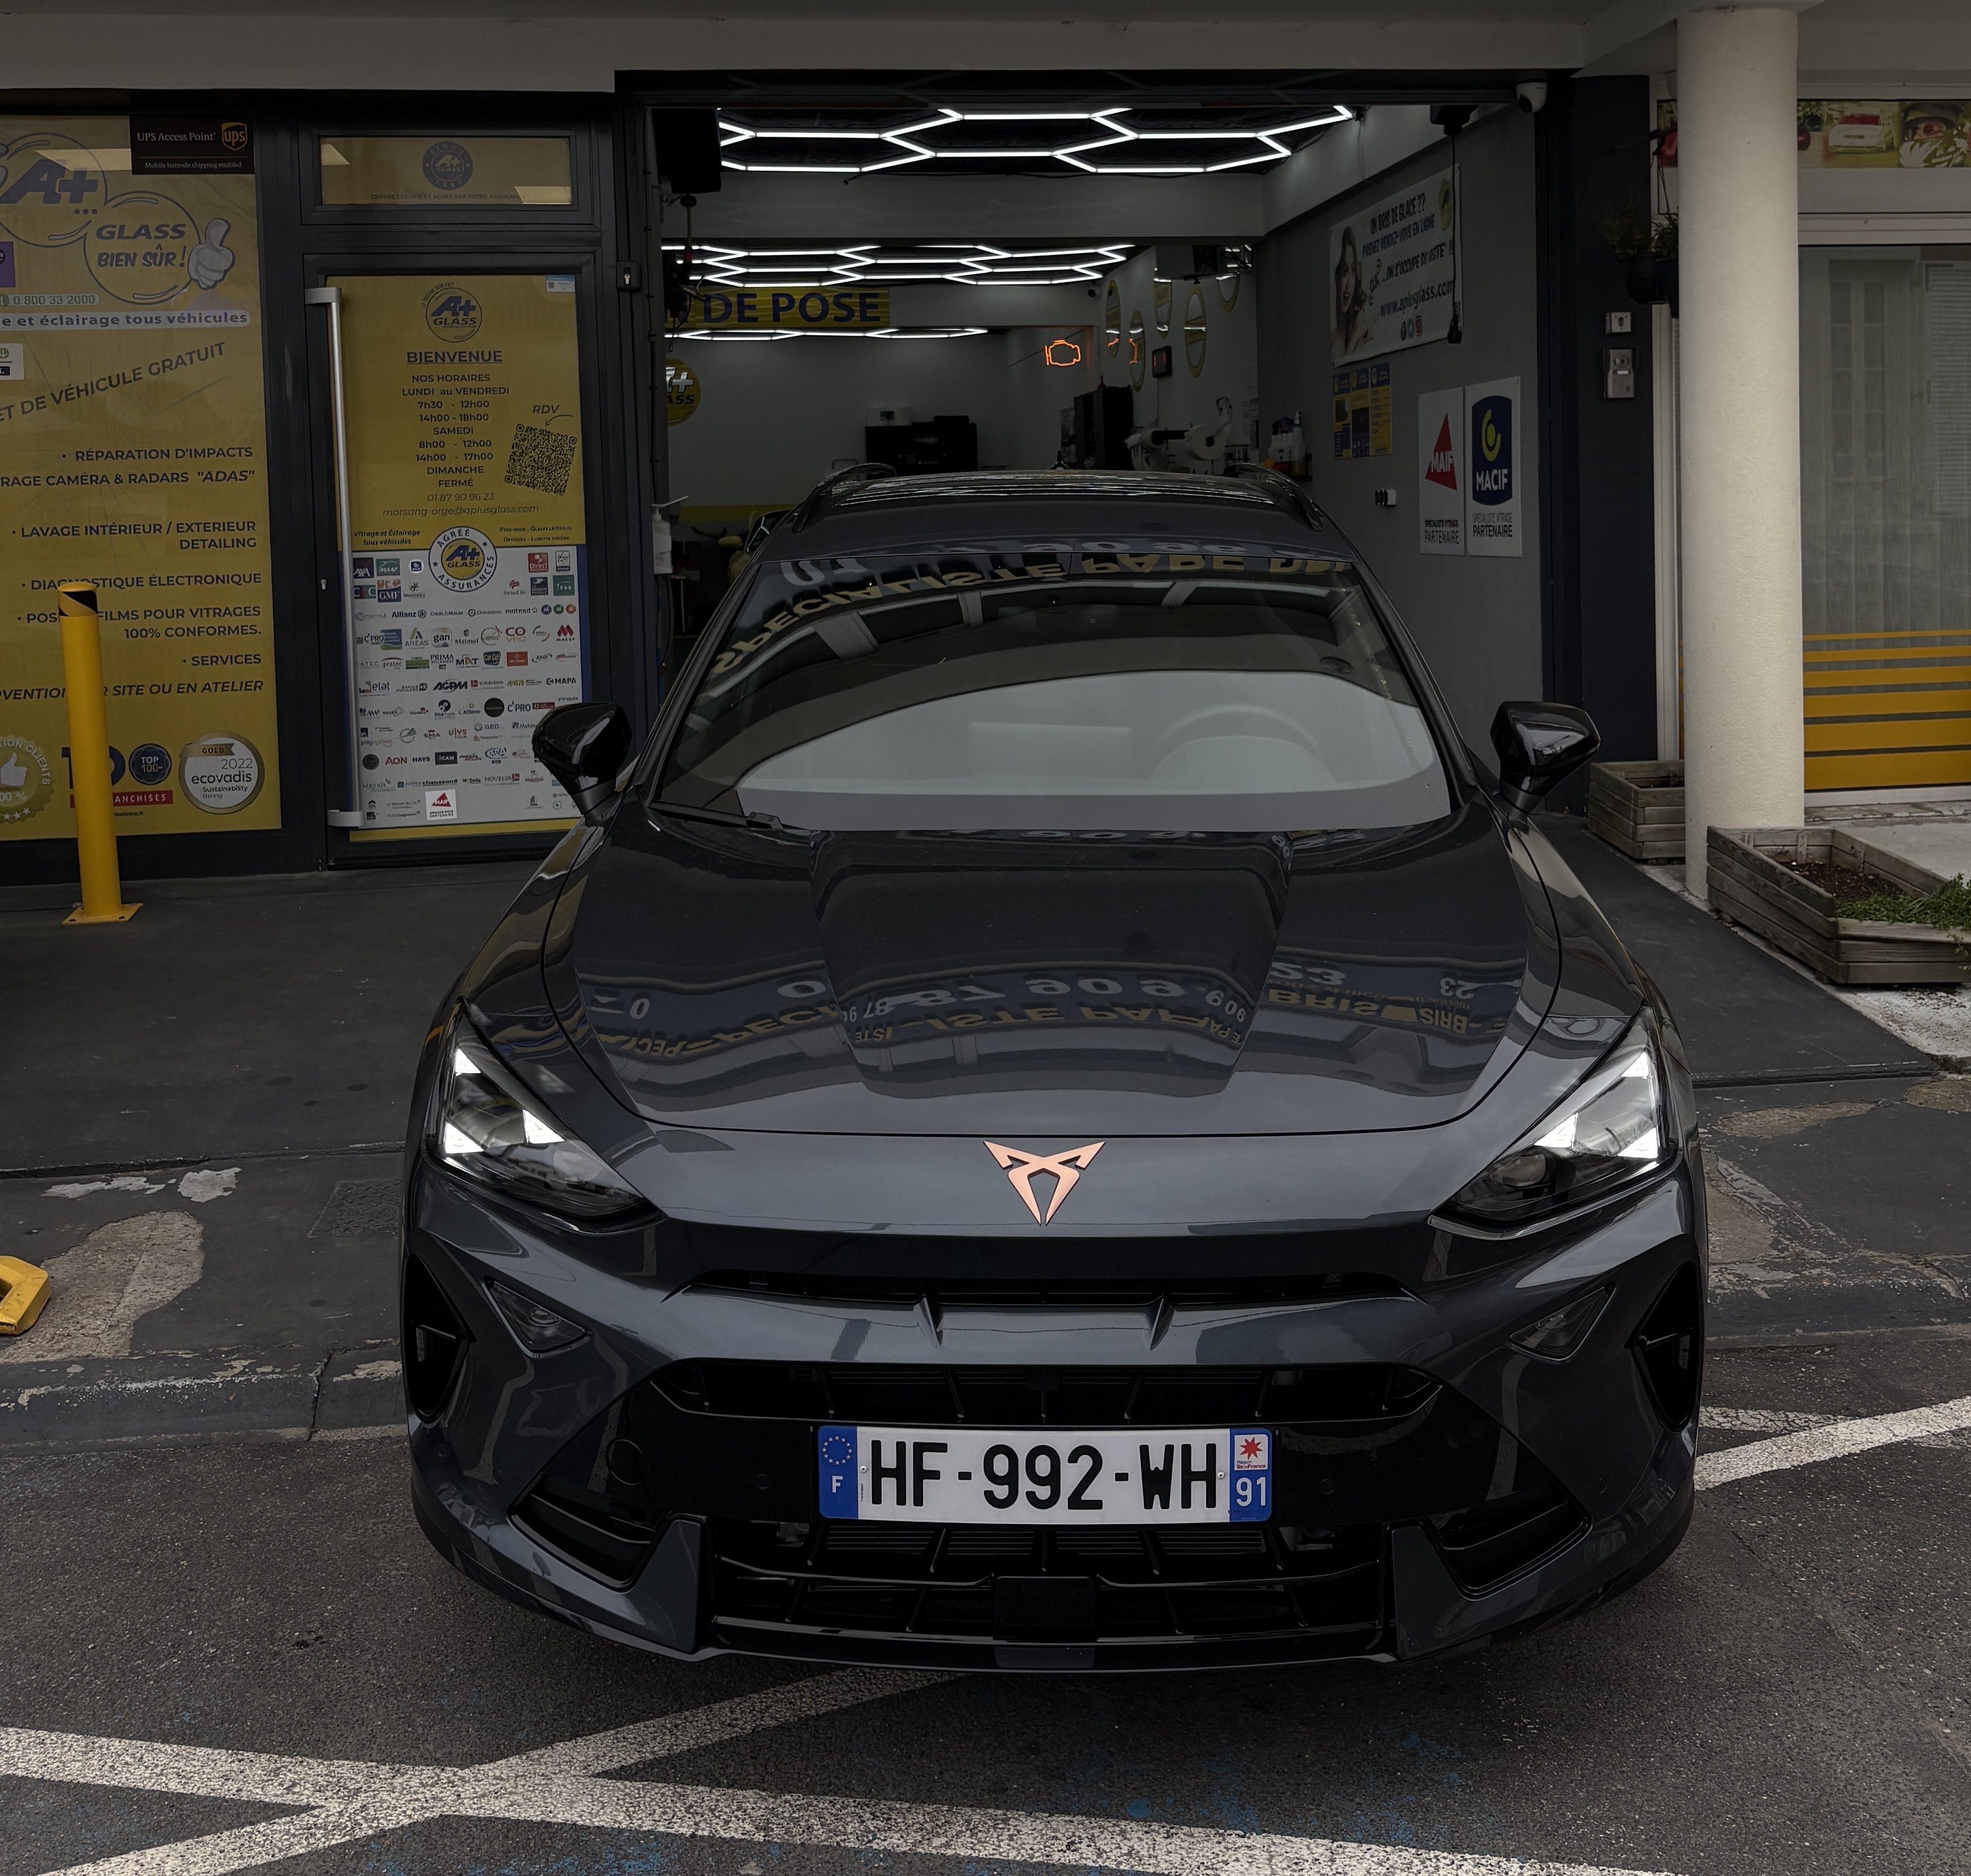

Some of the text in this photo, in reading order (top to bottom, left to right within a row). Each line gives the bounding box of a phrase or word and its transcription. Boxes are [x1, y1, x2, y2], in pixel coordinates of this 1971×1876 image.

[137, 132, 214, 141] UPS Access Point
[224, 131, 246, 146] ups
[2, 158, 98, 204] A+
[1370, 217, 1377, 235] UN
[1378, 212, 1390, 231] BRIS
[1392, 207, 1398, 225] DE
[1399, 197, 1417, 222] GLACE
[96, 224, 186, 240] GLASS
[98, 252, 137, 268] BIEN
[142, 244, 177, 268] SÛR
[14, 295, 96, 305] 0 800 33 2000
[431, 296, 476, 316] A+
[702, 293, 759, 323] DE
[772, 292, 881, 323] POSE
[18, 310, 248, 327] et éclairage tous véhicules
[407, 351, 503, 363] BIENVENUE
[21, 341, 225, 415] DE VÉHICULE GRATUIT
[412, 373, 490, 383] NOS HORAIRES
[402, 388, 434, 396] LUNDI
[455, 387, 510, 395] VENDREDI
[418, 400, 489, 409] 7h30 12h00
[532, 405, 560, 414] RDV
[419, 413, 489, 422] 14h00 18h00
[433, 427, 474, 435] SAMEDI
[419, 440, 492, 449] 8h00 12h00
[75, 447, 254, 461] RÉPARATION D'IMPACTS
[416, 453, 493, 462] 14h00 17h00
[1431, 450, 1454, 473] MAIF
[427, 465, 484, 475] DIMANCHE
[46, 473, 110, 486] CAMÉRA
[114, 473, 124, 484] &
[128, 472, 189, 484] RADARS
[197, 470, 255, 482] "ADAS"
[438, 478, 473, 488] FERMÉ
[1476, 469, 1509, 491] MACIF
[454, 493, 467, 501] 90
[383, 504, 539, 517] morsang-orge@aplusglass.com
[21, 525, 81, 537] LAVAGE
[85, 522, 162, 536] INTÉRIEUR
[177, 521, 256, 534] EXTERIEUR
[1473, 524, 1513, 538] PARTENAIRE
[180, 538, 257, 550] DETAILING
[437, 528, 470, 548] AGRÉÉ
[1424, 530, 1459, 544] PARTENAIRE
[445, 545, 480, 561] A+
[353, 567, 370, 577] AXA
[438, 556, 494, 590] ASSURANCES
[149, 573, 261, 587] ÉLECTRONIQUE
[379, 591, 400, 600] GMF
[27, 613, 58, 623] POS
[144, 608, 185, 620] POUR
[190, 606, 261, 619] VITRAGES
[125, 624, 262, 639] 100% CONFORMES.
[433, 633, 450, 643] gan
[192, 654, 261, 666] SERVICES
[112, 685, 145, 696] SITE
[149, 683, 171, 695] OU
[176, 683, 197, 694] EN
[201, 680, 264, 693] ATELIER
[25, 745, 51, 786] CLIENTS
[221, 758, 253, 770] 2022
[385, 756, 408, 765] AON
[191, 771, 252, 784] ecovadis
[203, 785, 248, 793] Sustainability
[871, 1439, 1217, 1511] HF-992-WH
[832, 1475, 843, 1493] F
[1235, 1476, 1267, 1507] 91
